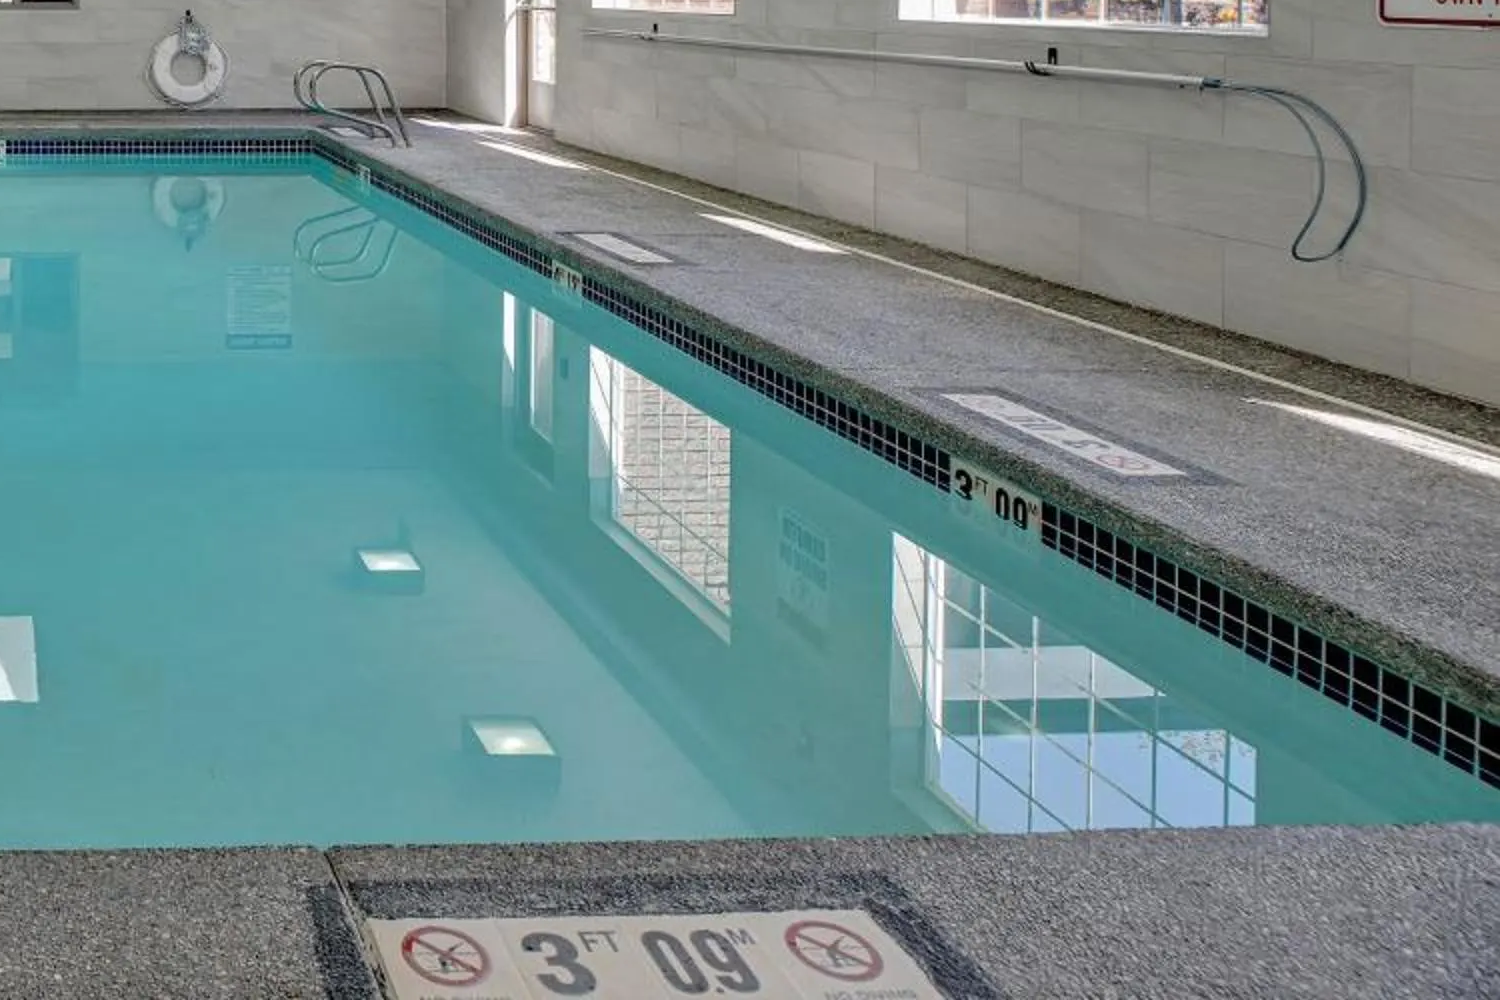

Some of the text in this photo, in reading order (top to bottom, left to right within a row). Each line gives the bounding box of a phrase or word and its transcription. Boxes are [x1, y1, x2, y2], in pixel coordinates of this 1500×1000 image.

[521, 928, 761, 996] 3 FT 0.9 M
